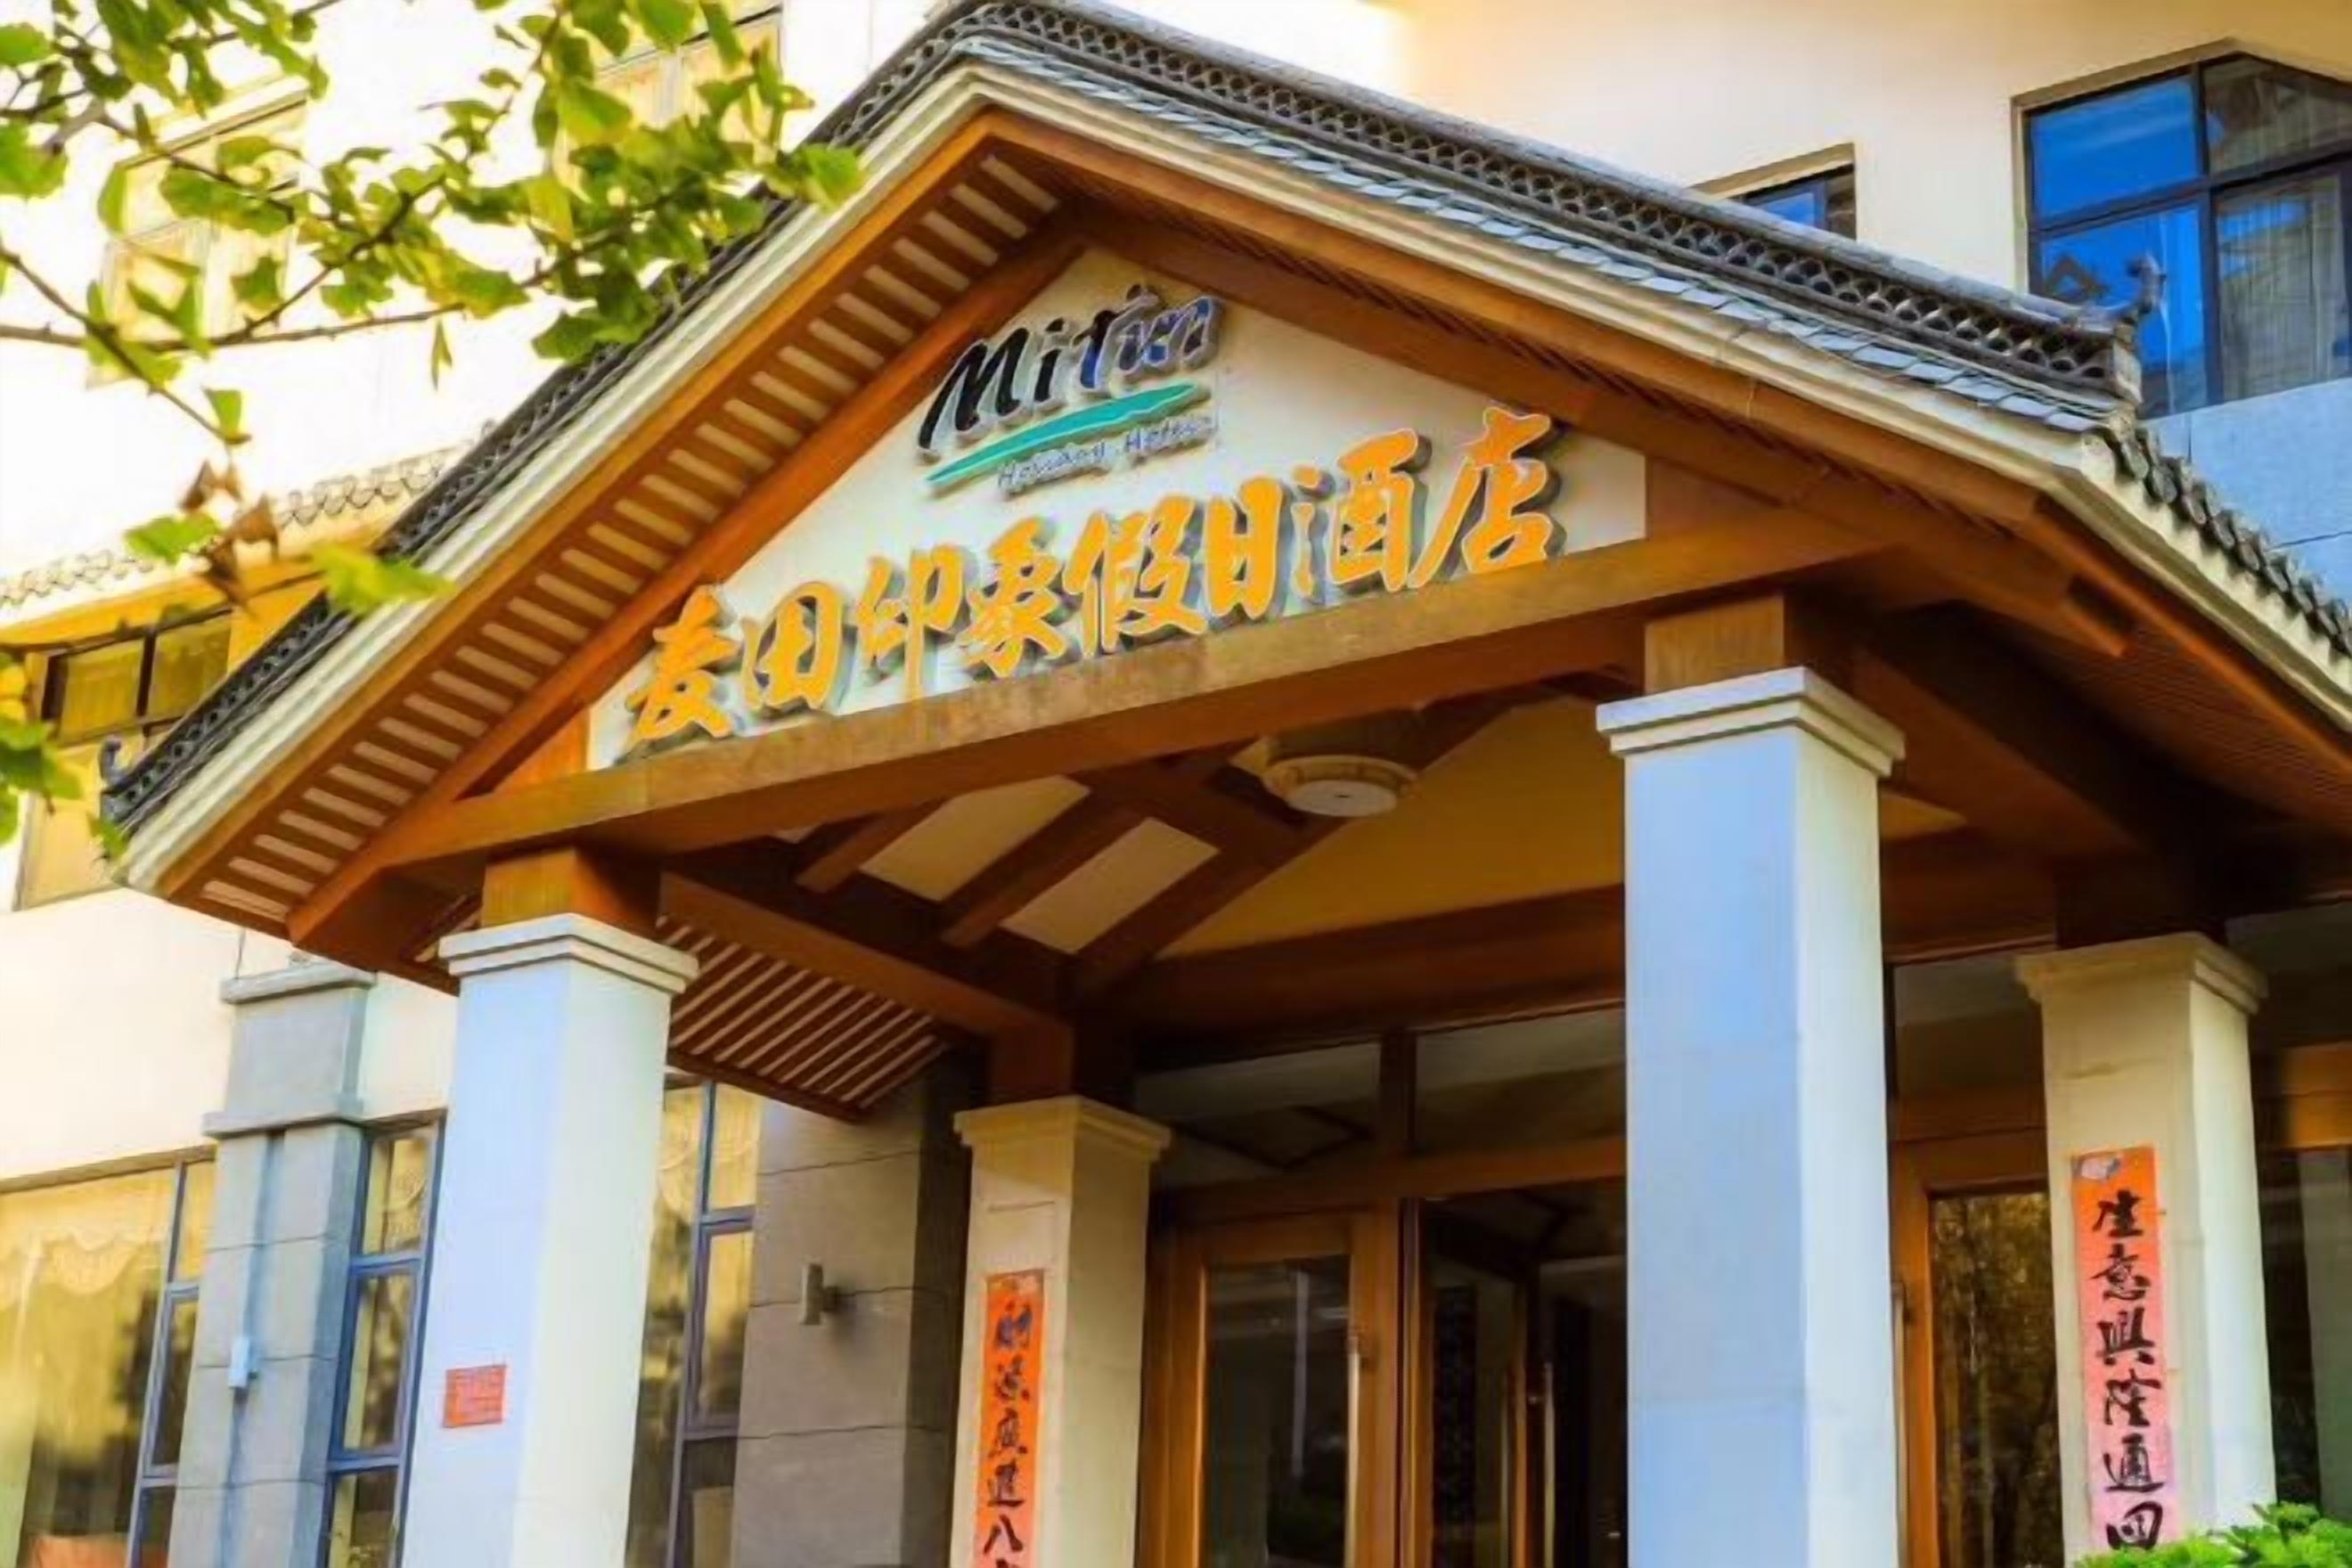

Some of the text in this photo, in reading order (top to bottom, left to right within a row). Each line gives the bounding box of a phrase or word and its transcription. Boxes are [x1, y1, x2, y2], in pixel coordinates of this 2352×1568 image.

[625, 406, 1553, 745] 麦田印象假日酒店
